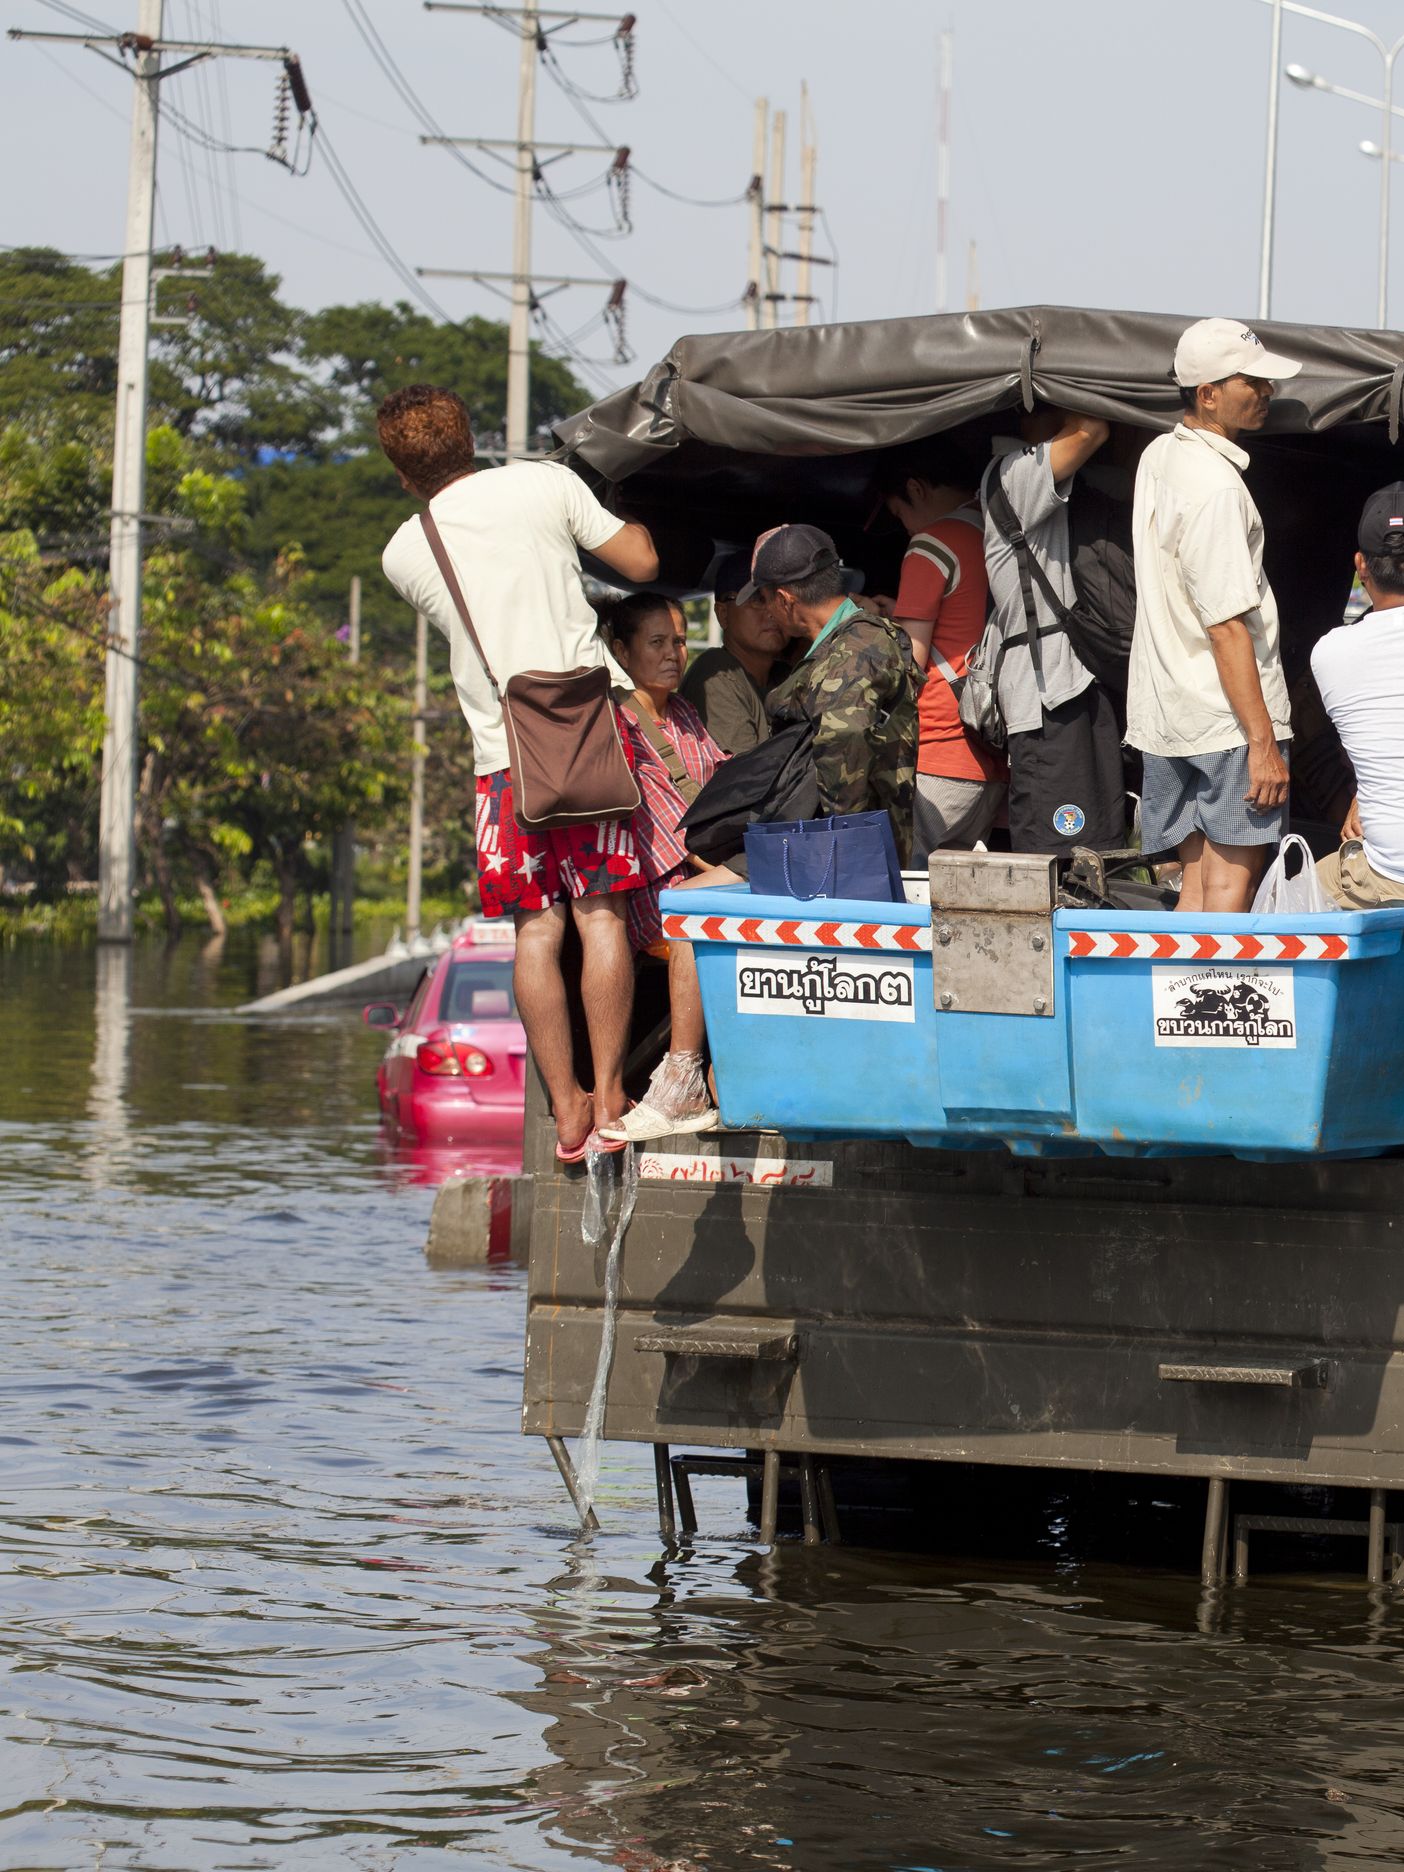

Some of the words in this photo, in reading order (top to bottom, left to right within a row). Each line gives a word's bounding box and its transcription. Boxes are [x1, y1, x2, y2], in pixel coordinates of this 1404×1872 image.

[1157, 1013, 1293, 1045] ขบวนการกู้โลก
